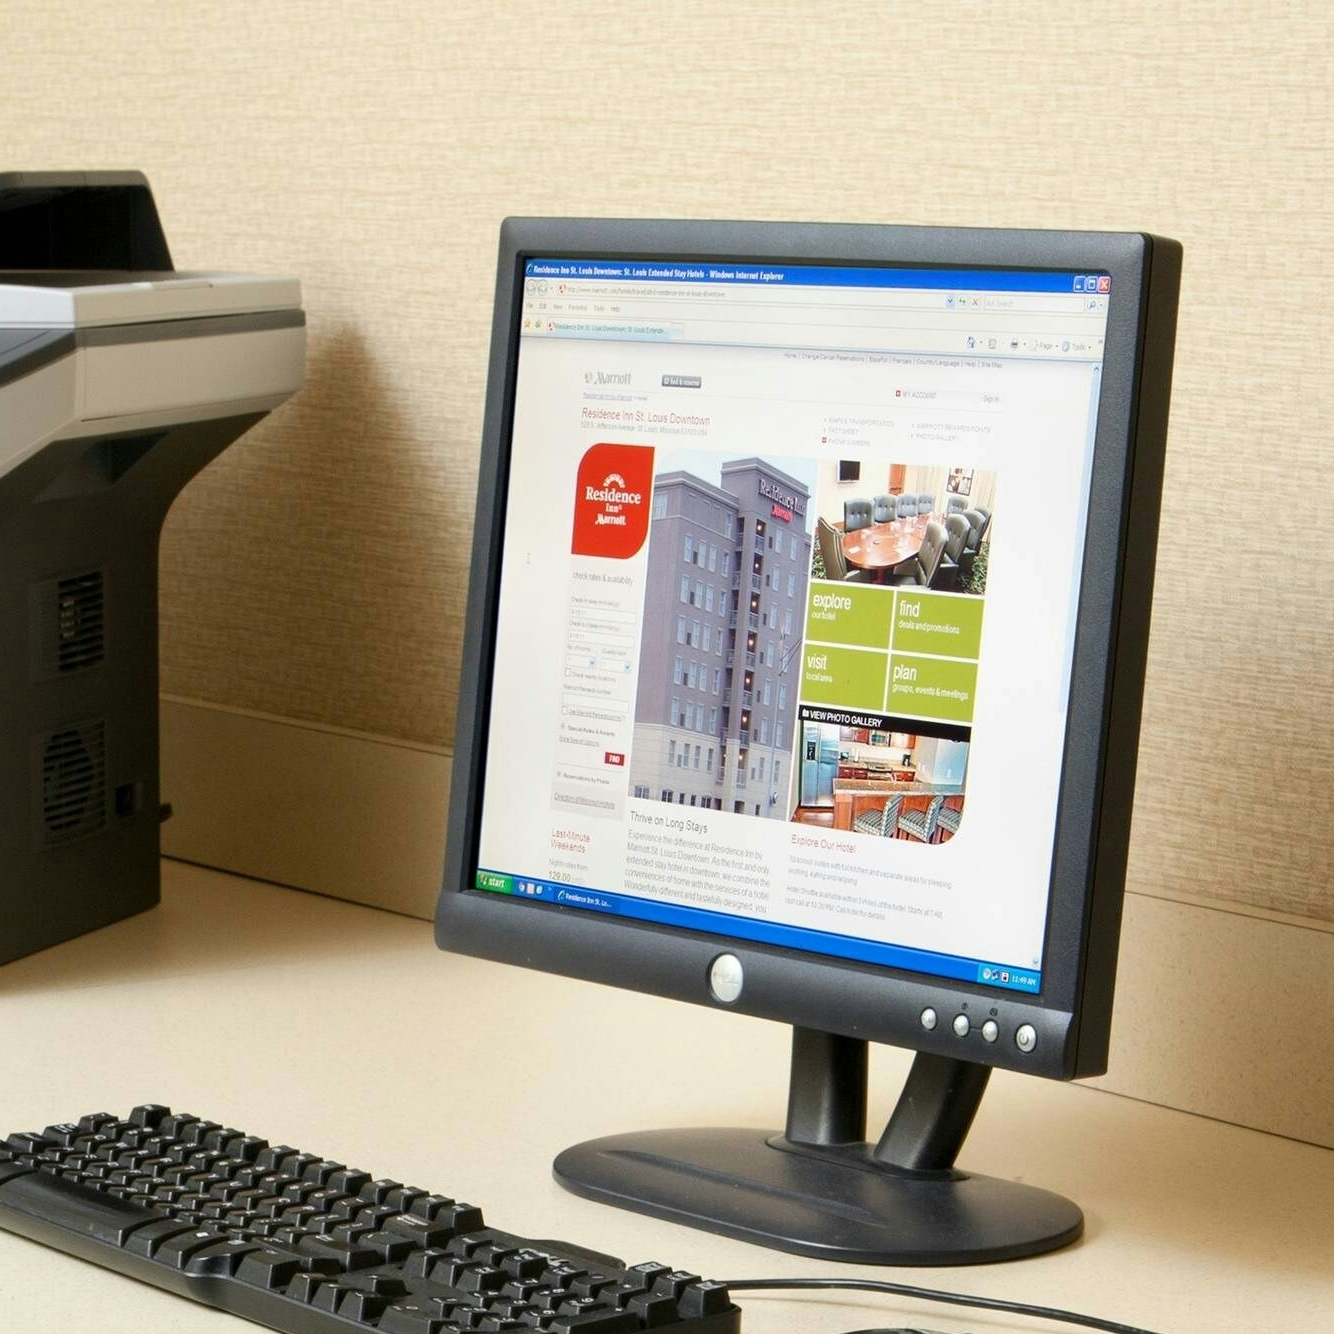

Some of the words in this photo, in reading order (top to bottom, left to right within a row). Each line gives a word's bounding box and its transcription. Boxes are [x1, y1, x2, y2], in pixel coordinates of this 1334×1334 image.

[533, 265, 559, 275] Residence
[561, 267, 569, 275] Inn
[579, 268, 592, 276] Louis
[633, 270, 646, 278] Louis
[648, 270, 673, 279] Extended
[674, 271, 686, 280] Stay
[687, 271, 704, 279] Hotels
[709, 272, 734, 281] Windows
[736, 273, 757, 282] Internet
[760, 274, 784, 283] Explorer
[594, 372, 631, 385] Marriott
[581, 408, 621, 421] Residence
[622, 412, 634, 423] Inn
[648, 414, 667, 424] Louis
[670, 413, 710, 426] Downtown
[585, 486, 641, 504] Residence
[813, 593, 851, 612] explore
[900, 600, 920, 618] find
[807, 654, 827, 670] visit
[893, 665, 917, 681] plan
[810, 711, 826, 721] VIEW
[827, 712, 850, 723] PHOTO
[851, 716, 882, 727] GALLERY
[630, 811, 653, 824] Thrive
[655, 816, 663, 825] on
[666, 818, 684, 832] Long
[685, 821, 708, 835] Stays
[791, 834, 819, 848] Explore
[821, 839, 834, 850] Our
[836, 841, 856, 854] Hotel
[488, 877, 505, 888] start
